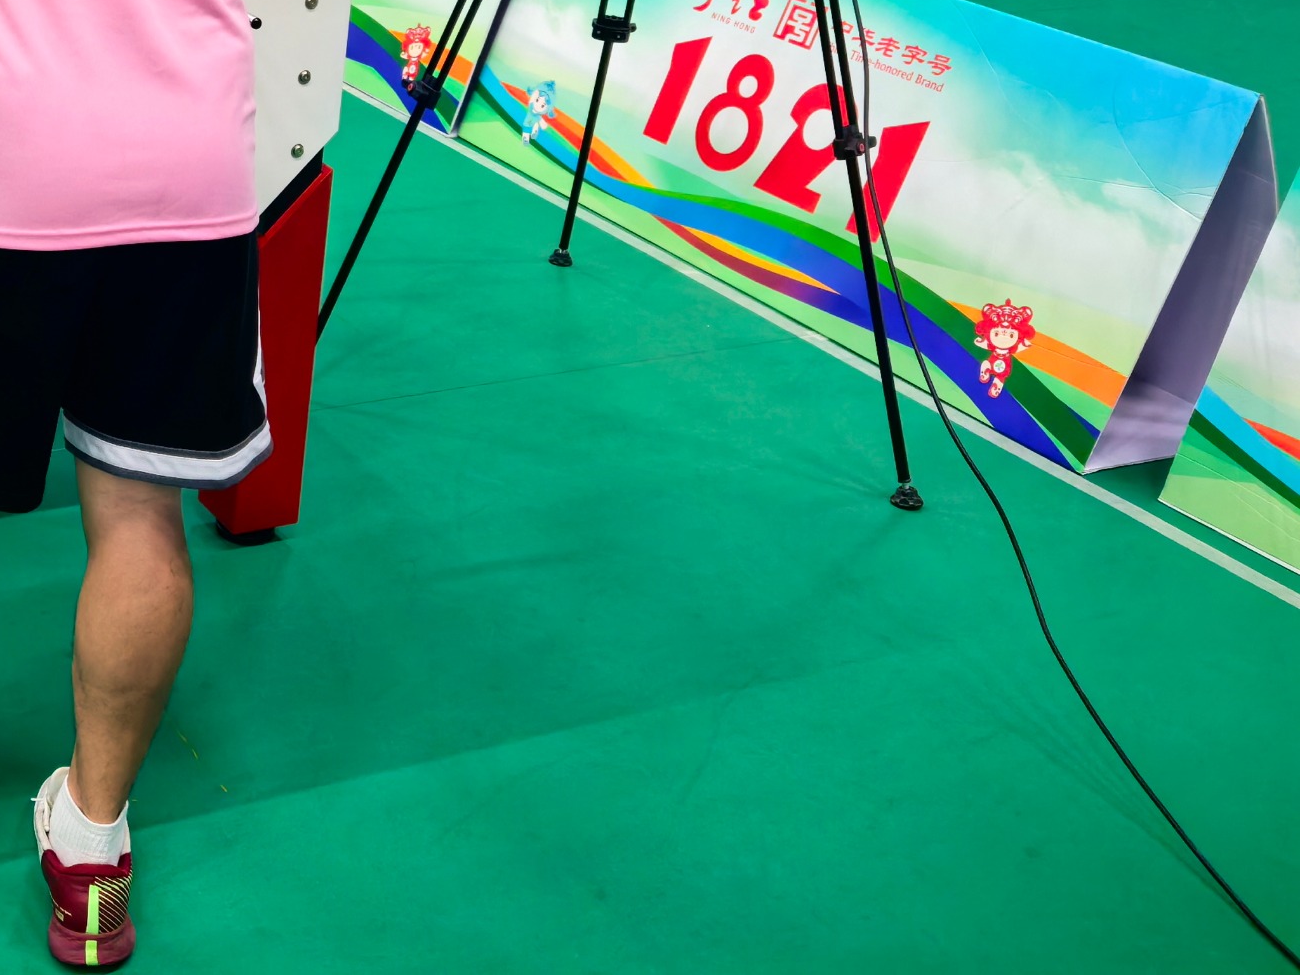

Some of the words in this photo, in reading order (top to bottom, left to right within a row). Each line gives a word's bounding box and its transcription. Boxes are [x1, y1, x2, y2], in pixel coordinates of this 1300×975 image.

[711, 12, 731, 25] NING
[734, 21, 756, 34] HONG
[915, 75, 945, 93] Brand
[642, 35, 931, 244] 1821
